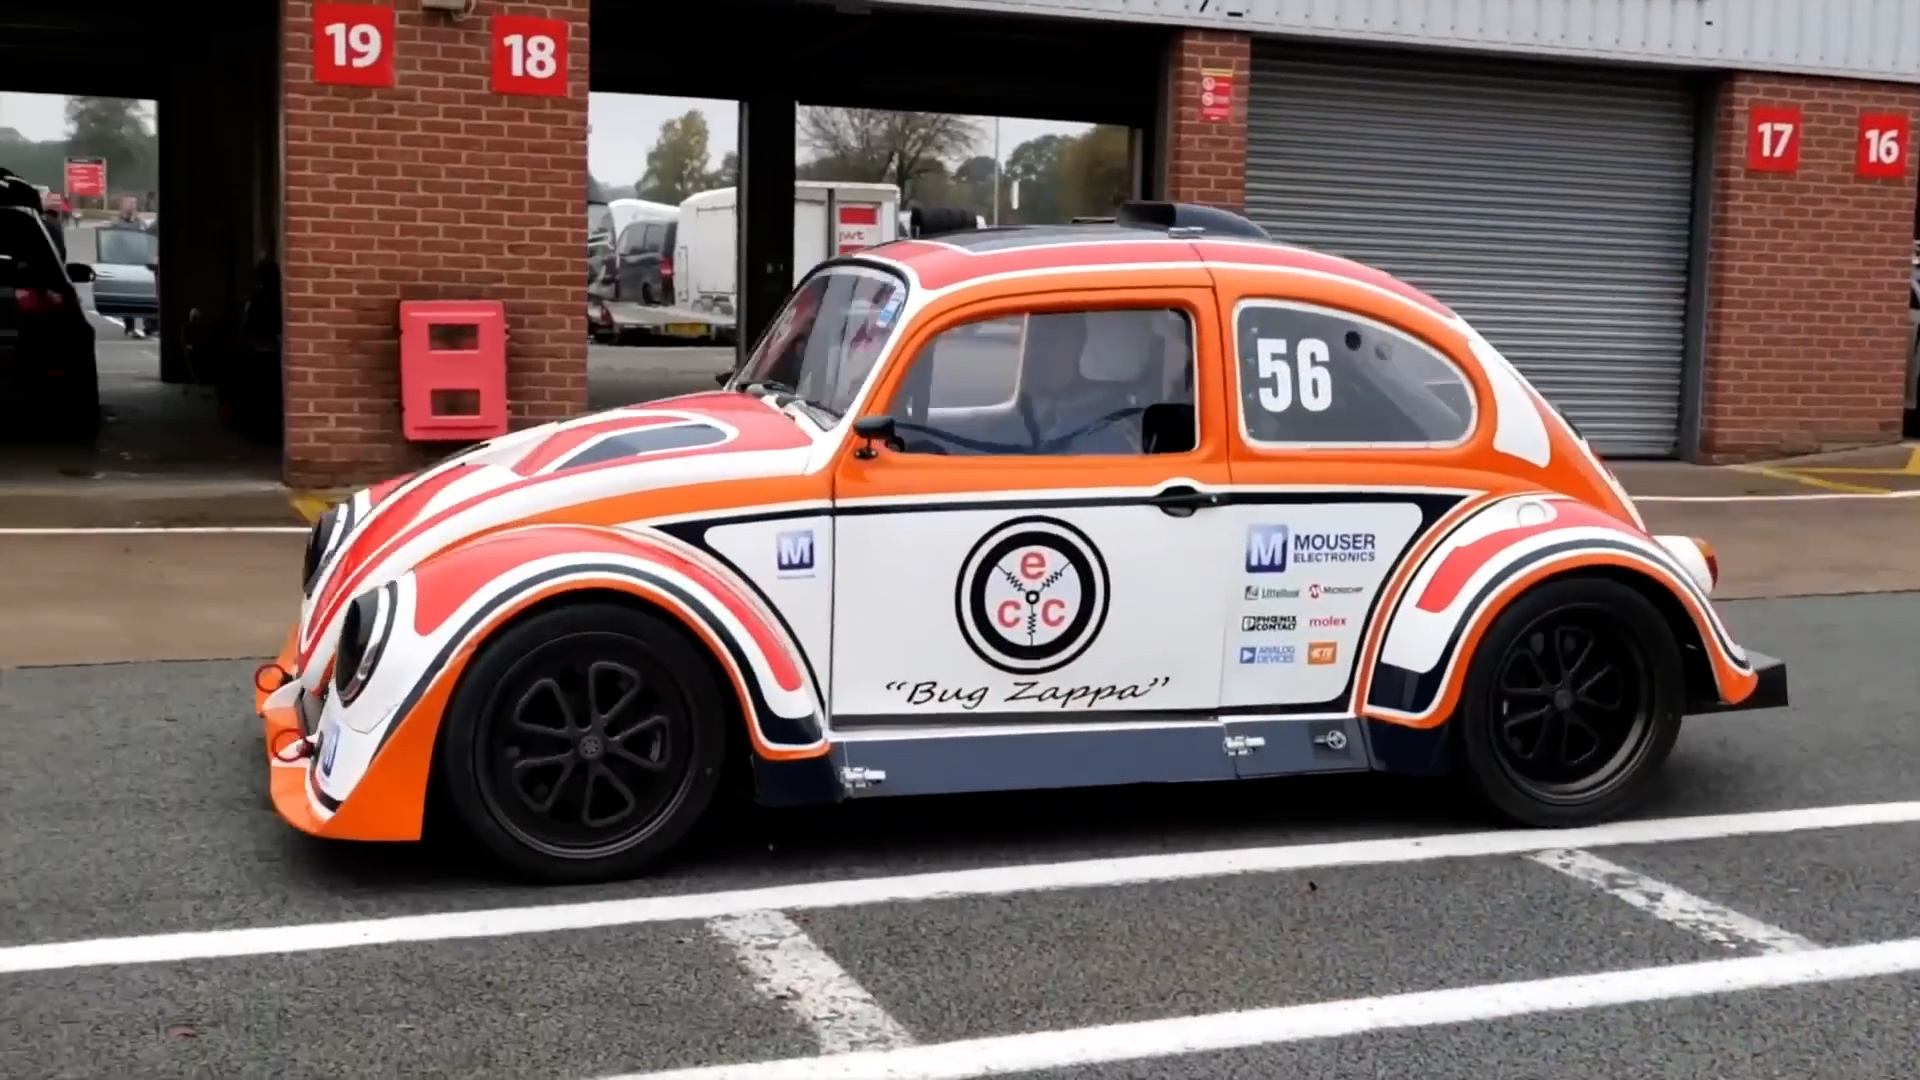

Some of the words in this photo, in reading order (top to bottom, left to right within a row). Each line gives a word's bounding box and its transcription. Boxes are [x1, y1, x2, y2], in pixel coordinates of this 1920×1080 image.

[324, 22, 382, 68] 19
[503, 34, 557, 79] 18
[1757, 122, 1794, 158] 17
[1864, 129, 1900, 164] 16
[1257, 338, 1332, 412] 56
[780, 536, 811, 566] M
[1249, 532, 1284, 567] M
[1293, 533, 1376, 551] MOUSER
[1293, 551, 1376, 563] ELECTRONICS
[1309, 615, 1347, 627] molex
